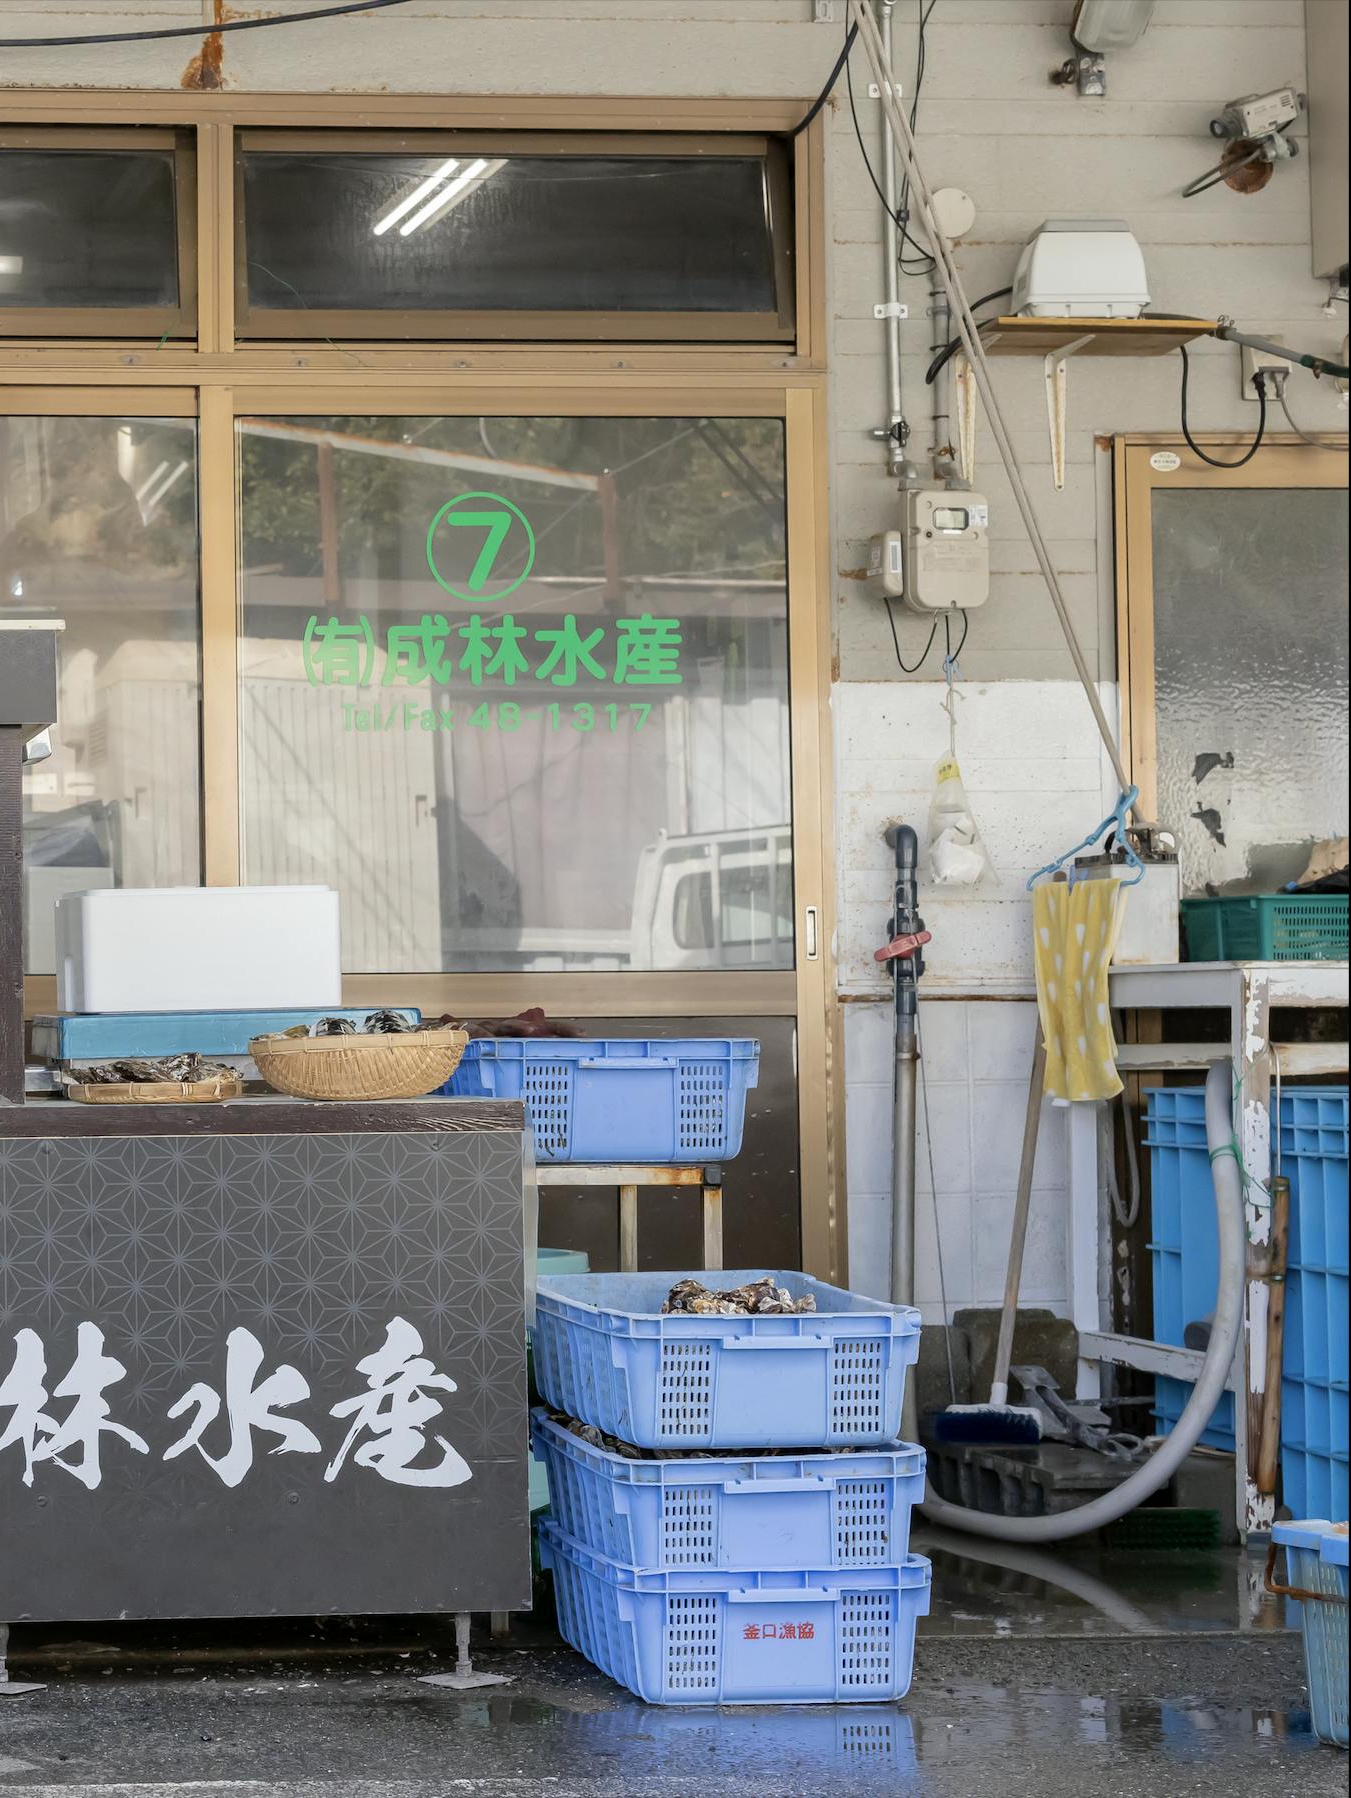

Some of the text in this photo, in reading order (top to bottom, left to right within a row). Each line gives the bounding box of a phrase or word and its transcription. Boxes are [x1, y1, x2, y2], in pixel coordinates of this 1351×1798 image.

[341, 701, 653, 734] Tel/Fax 48-1317
[743, 1622, 815, 1640] 釜口漁協
